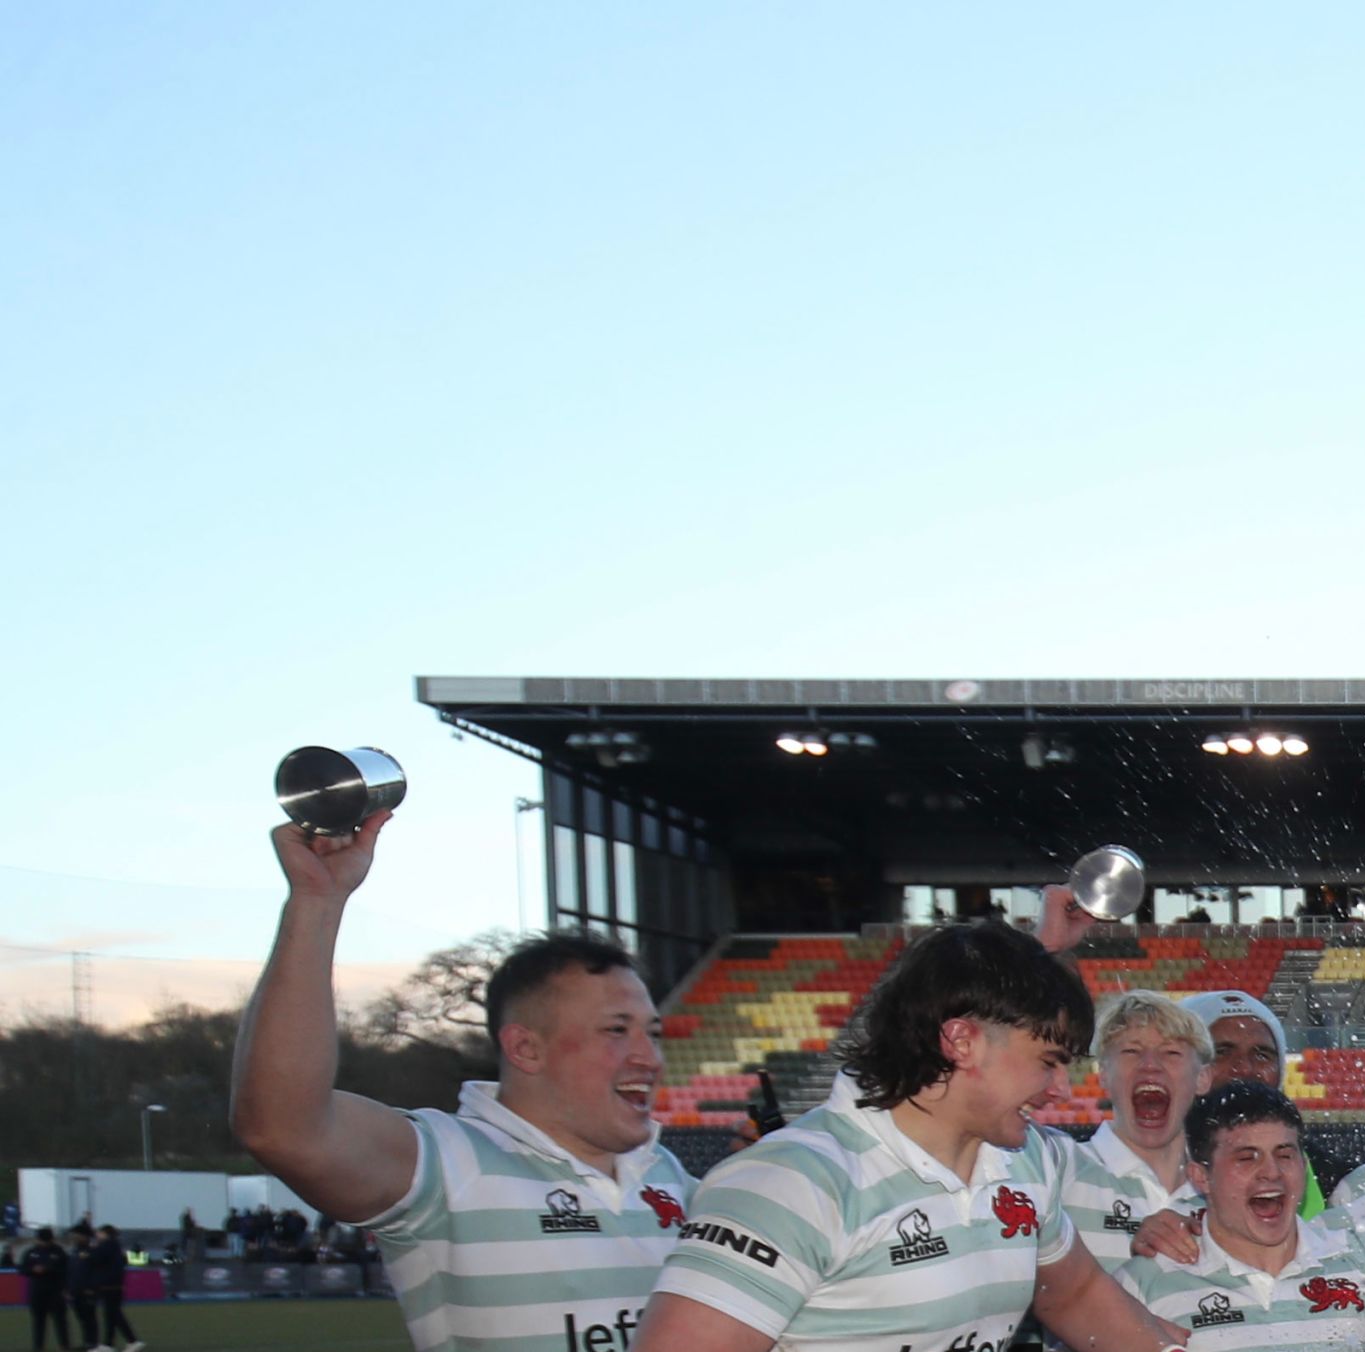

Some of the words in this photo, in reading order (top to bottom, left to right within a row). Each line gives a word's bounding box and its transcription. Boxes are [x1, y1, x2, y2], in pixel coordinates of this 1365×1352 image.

[1144, 682, 1245, 698] DISCIPLINE
[540, 1217, 600, 1232] RHINO
[890, 1240, 949, 1263] RHINO
[1191, 1311, 1245, 1327] RHINO
